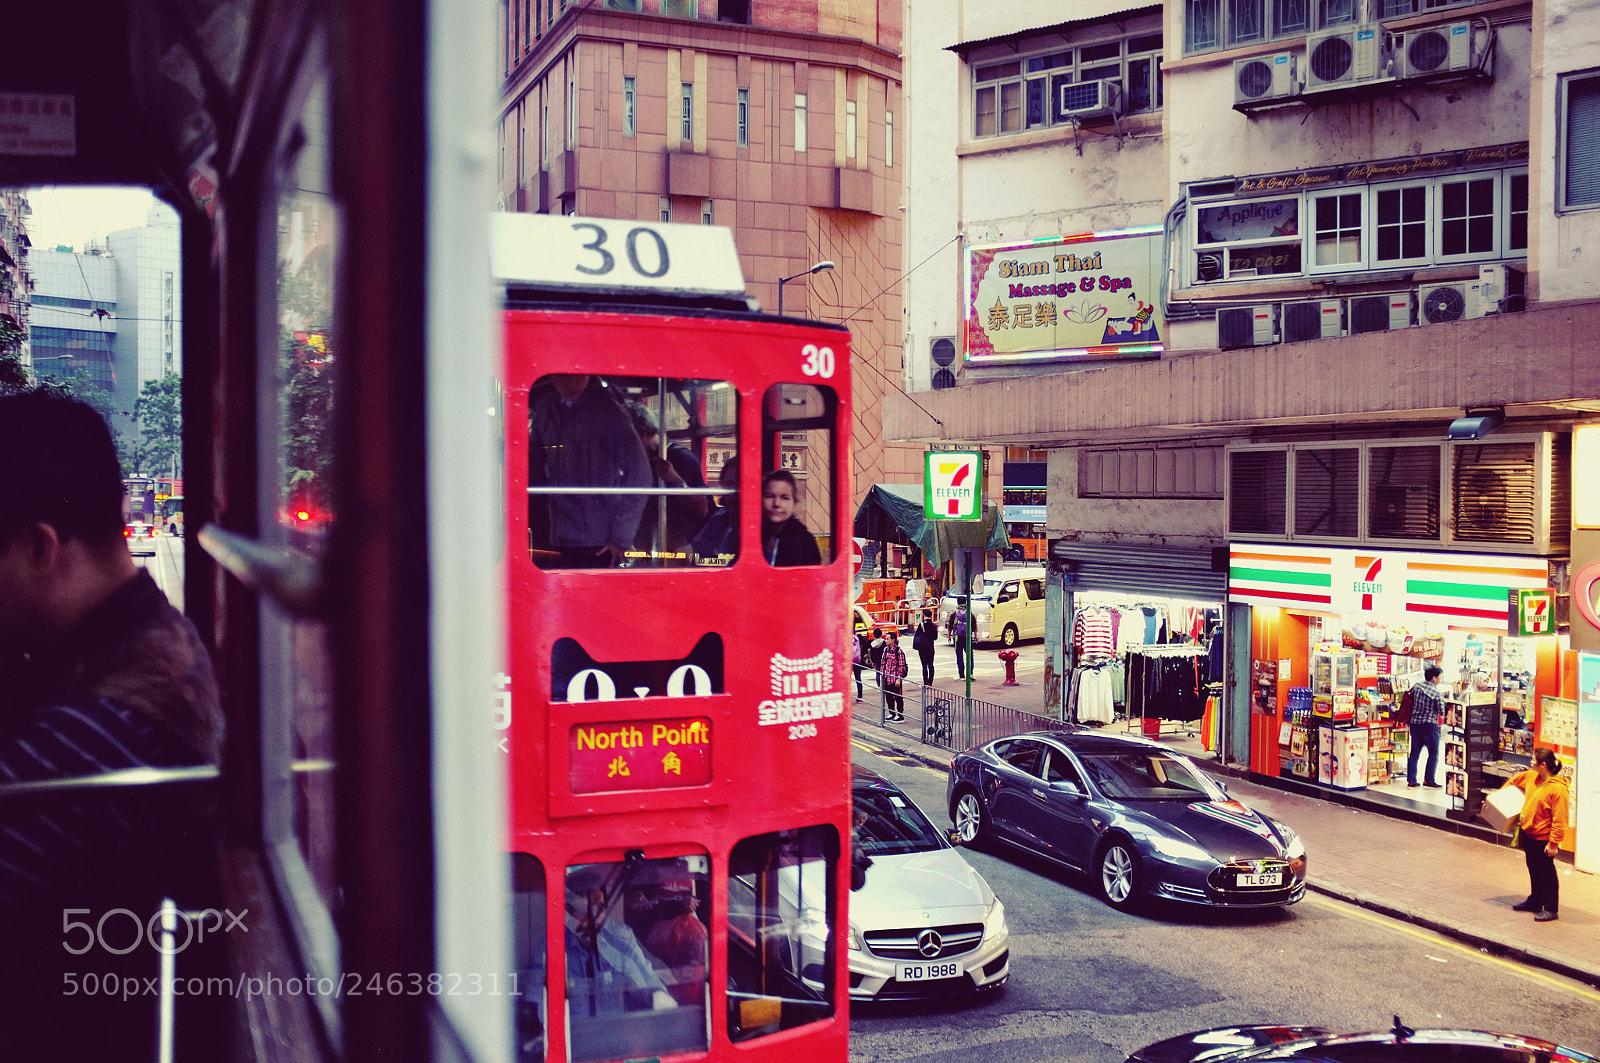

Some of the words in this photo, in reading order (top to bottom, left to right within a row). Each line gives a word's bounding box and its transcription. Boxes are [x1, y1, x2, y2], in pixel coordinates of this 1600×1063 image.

[1217, 203, 1283, 227] Applique
[571, 223, 671, 279] 30
[999, 259, 1050, 279] Siam
[1053, 251, 1103, 273] Thai
[1008, 280, 1076, 299] Massage
[1079, 276, 1096, 293] &
[1098, 275, 1133, 293] Spa
[988, 297, 1058, 331] 泰足樂
[801, 344, 836, 379] 30
[939, 463, 970, 516] 7
[1355, 556, 1383, 611] 7
[1527, 600, 1547, 632] 7
[782, 672, 822, 695] 11.11
[577, 726, 644, 751] North
[652, 721, 710, 747] Point
[788, 723, 818, 740] 2016
[1245, 875, 1257, 885] TL
[1259, 874, 1277, 885] 673
[904, 967, 923, 979] RD
[927, 964, 957, 978] 1988
